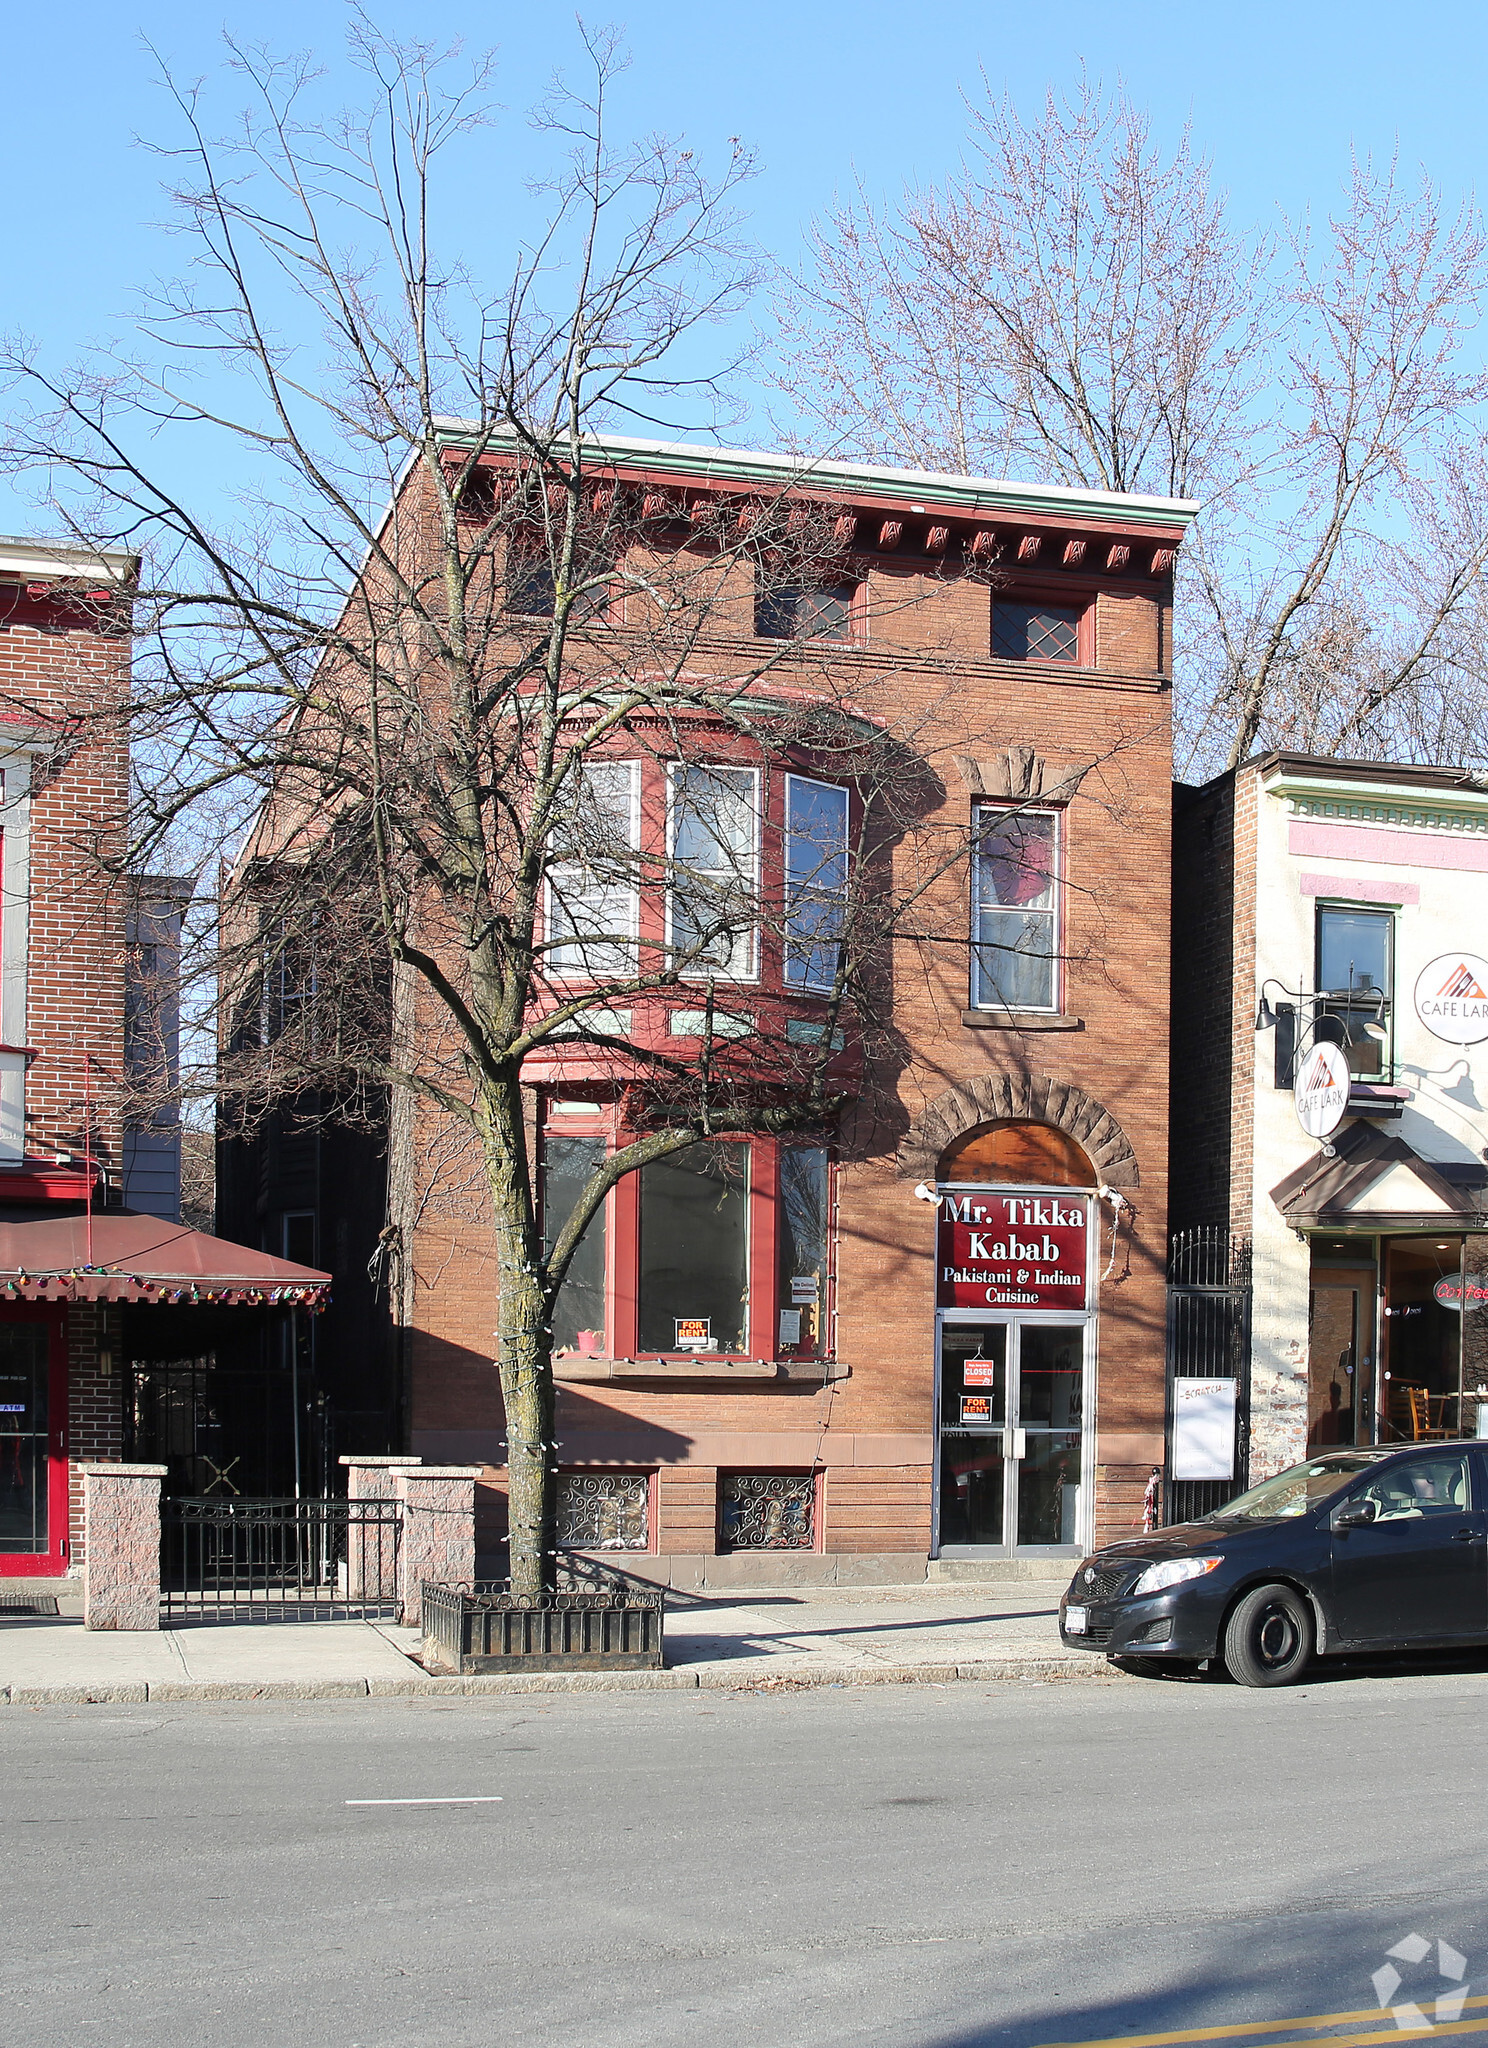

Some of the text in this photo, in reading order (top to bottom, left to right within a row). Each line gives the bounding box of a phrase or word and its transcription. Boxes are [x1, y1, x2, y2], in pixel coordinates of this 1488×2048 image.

[1421, 1000, 1457, 1017] CAFE
[1298, 1090, 1344, 1113] CAFE LARK
[943, 1196, 1085, 1227] Mr. Tikka
[968, 1232, 1060, 1262] Kabab
[943, 1266, 1081, 1285] Pakistani & Indian
[985, 1286, 1039, 1304] Cuisine
[678, 1329, 707, 1337] RENT
[682, 1321, 703, 1330] FOR
[965, 1368, 992, 1376] CLOSED
[967, 1398, 986, 1406] FOR
